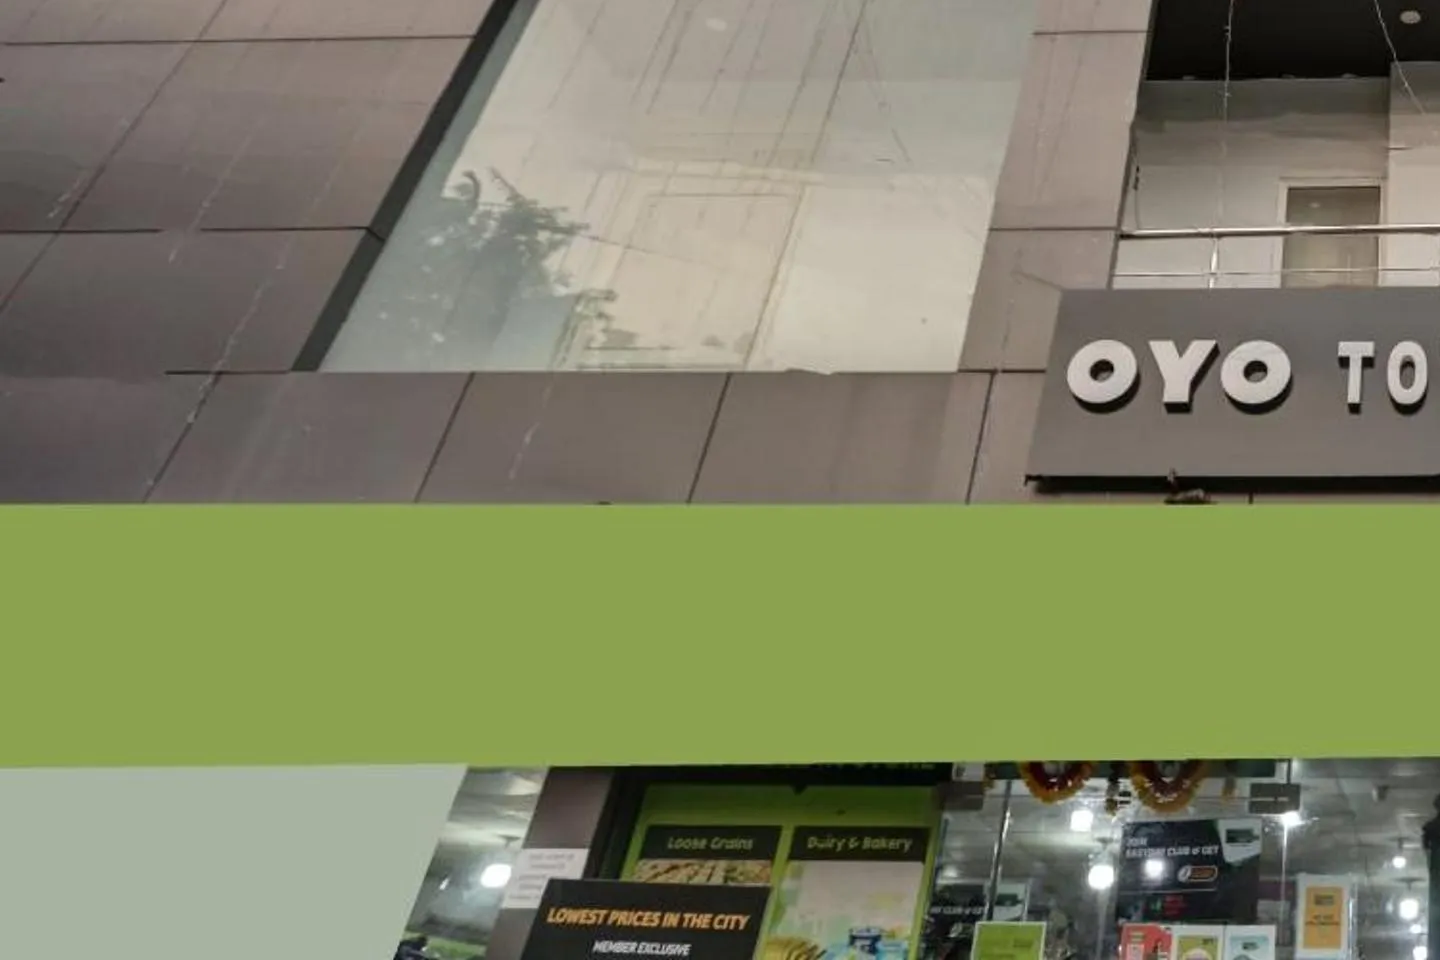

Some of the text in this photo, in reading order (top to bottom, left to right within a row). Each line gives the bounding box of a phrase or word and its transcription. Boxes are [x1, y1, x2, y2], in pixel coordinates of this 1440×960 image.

[1066, 339, 1293, 414] OYO
[667, 836, 754, 851] Loose Grains
[807, 836, 846, 852] Dairy
[862, 836, 914, 852] Bakery
[547, 908, 750, 931] LOWEST PRICES IN THE CITY
[593, 941, 692, 957] MEMBER EXCLUSIVE
